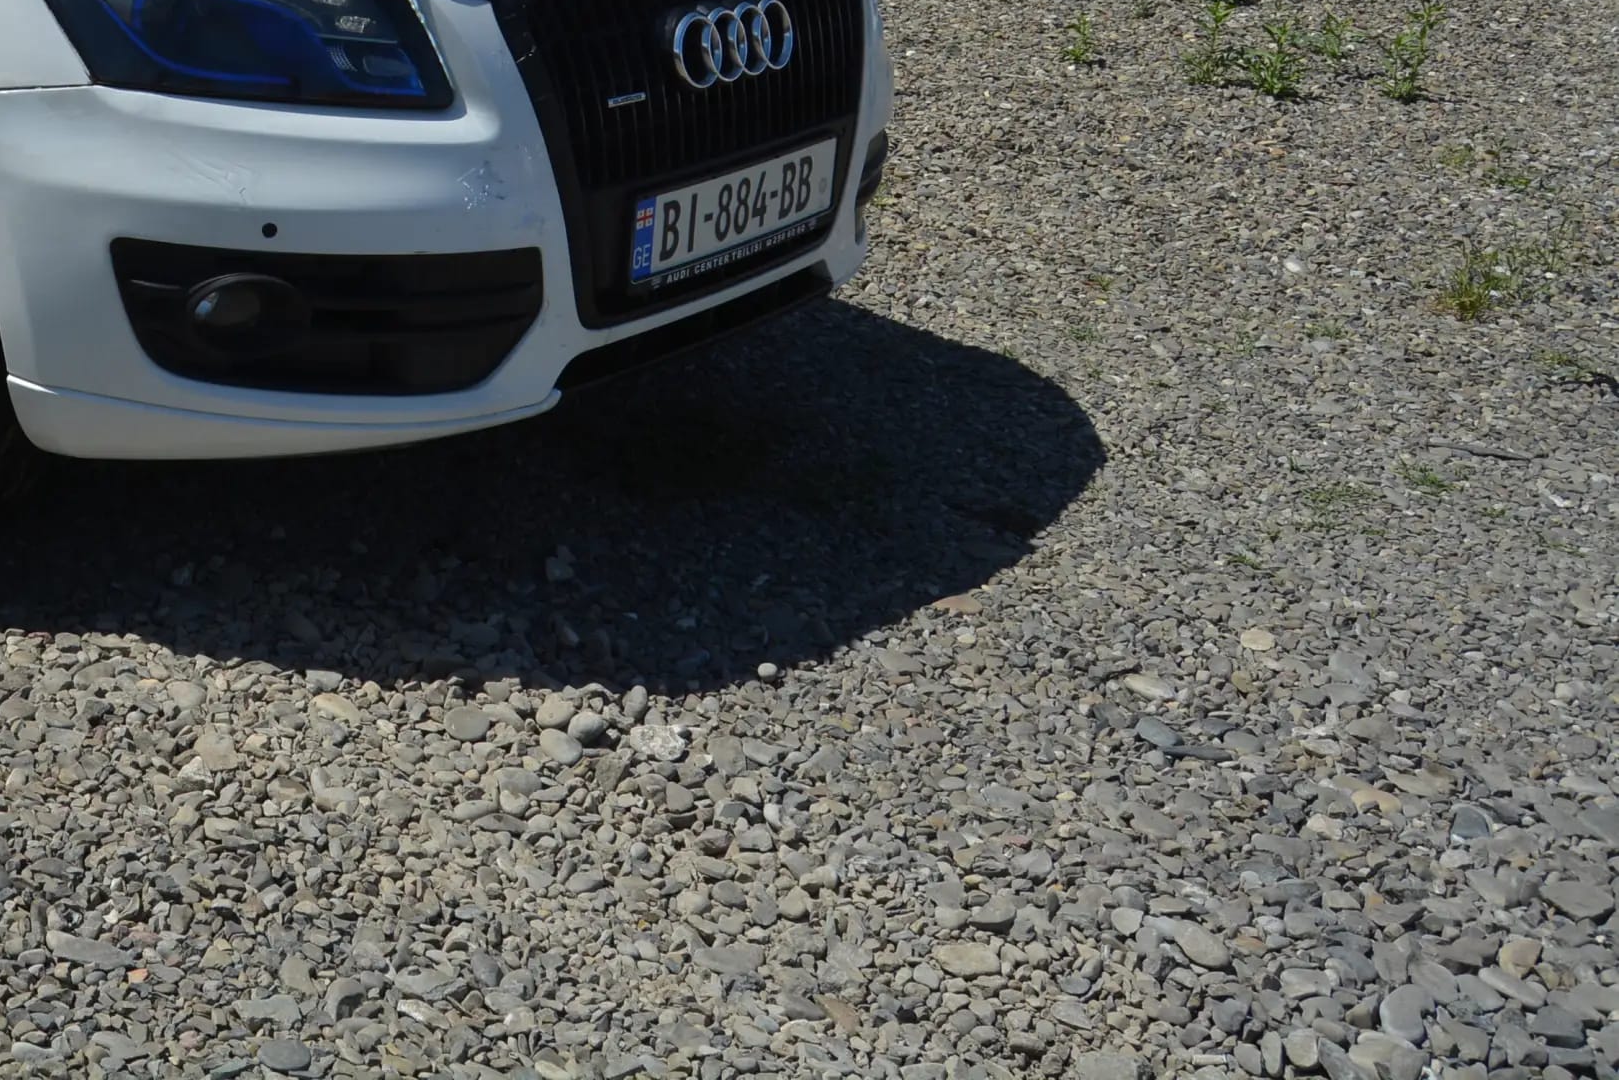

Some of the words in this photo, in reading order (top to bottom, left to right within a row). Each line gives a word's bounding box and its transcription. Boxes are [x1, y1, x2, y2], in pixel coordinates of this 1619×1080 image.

[658, 155, 814, 262] BI-884-BB
[632, 243, 651, 270] GE
[666, 266, 690, 285] AUDI
[693, 252, 730, 276] CENTER
